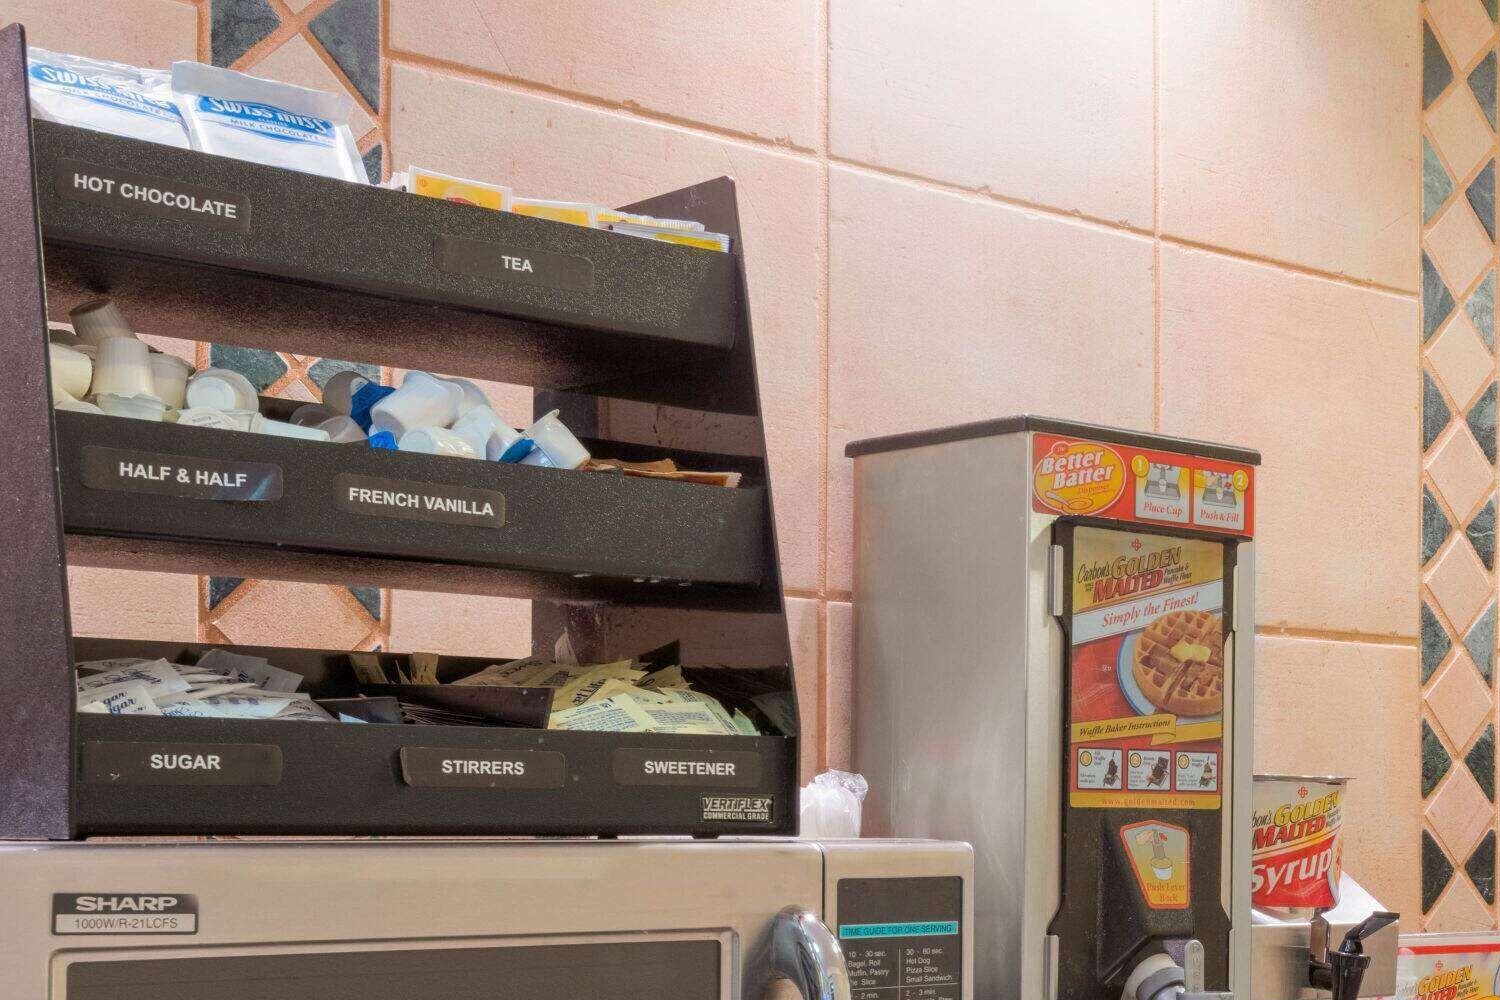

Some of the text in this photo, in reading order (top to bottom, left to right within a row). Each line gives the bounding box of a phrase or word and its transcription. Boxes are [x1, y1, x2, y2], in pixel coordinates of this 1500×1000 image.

[74, 173, 237, 219] HOT CHOCOLATE
[501, 255, 533, 273] TEA
[1041, 449, 1104, 476] Better
[1138, 458, 1143, 471] 1
[119, 462, 247, 488] HALF & HALF
[1053, 464, 1115, 490] Batter
[1236, 473, 1244, 486] 2
[349, 487, 494, 517] FRENCH VANILLA
[1143, 502, 1183, 517] Place Cup
[1200, 509, 1218, 520] Push
[1226, 513, 1239, 523] Fill
[1111, 546, 1181, 580] GOLDEN
[1093, 569, 1164, 603] MALTED
[1102, 592, 1199, 627] Simply the Finest!
[1080, 719, 1170, 736] Waffle Baker Instructions
[150, 754, 221, 770] SUGAR
[442, 759, 525, 776] STIRRERS
[644, 761, 736, 777] SWEETENER
[702, 797, 770, 812] VERTIFLEX
[1274, 790, 1340, 828] GOLDEN
[703, 811, 769, 820] COMMERCIAL GRADE
[1252, 815, 1327, 851] MALTED
[1252, 848, 1332, 896] Syrup
[76, 896, 178, 912] SHARP
[74, 917, 178, 930] 1000W/R-21LCFS
[844, 924, 952, 936] TIME GUIDE FOR ONE SERVING
[918, 957, 931, 965] Dog
[924, 974, 952, 982] Sandwich
[1417, 964, 1473, 997] GOLDEN
